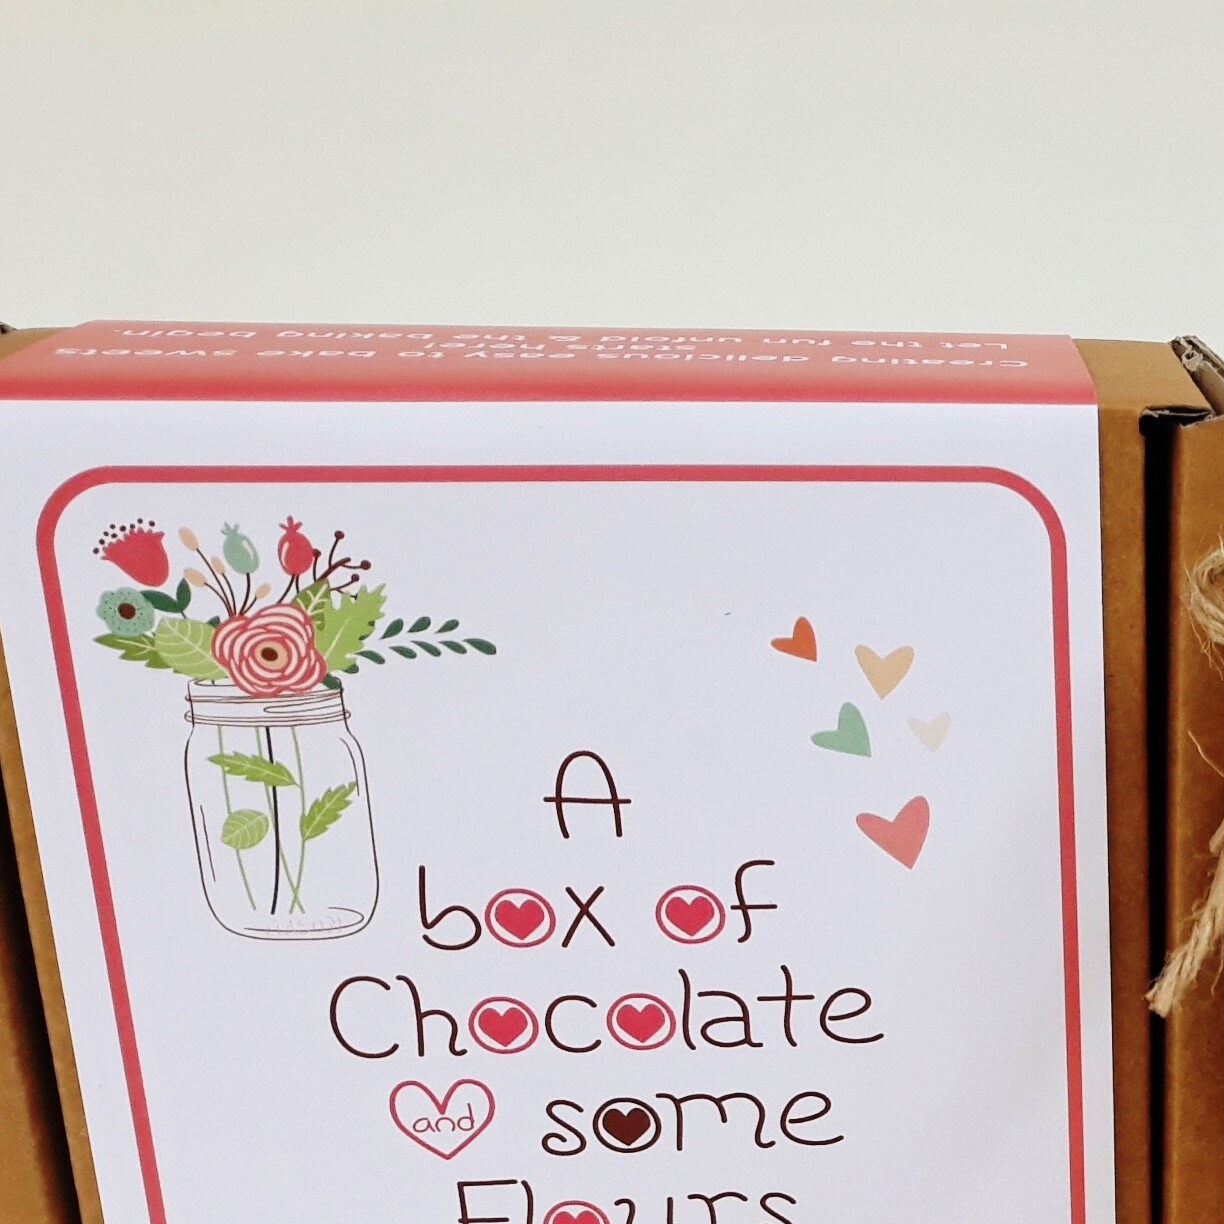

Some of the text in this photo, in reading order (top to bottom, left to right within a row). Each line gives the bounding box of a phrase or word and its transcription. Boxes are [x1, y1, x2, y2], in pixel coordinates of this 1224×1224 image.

[276, 330, 434, 340] baking
[600, 335, 743, 343] unfold
[850, 340, 923, 348] the
[939, 342, 1009, 350] Let
[53, 348, 237, 356] sweets
[256, 350, 376, 358] bake
[596, 353, 810, 362] delicious
[830, 355, 1029, 367] Creating
[543, 750, 632, 839] A
[419, 859, 777, 951] box of
[329, 964, 885, 1058] Chocolate
[411, 1090, 844, 1156] and some
